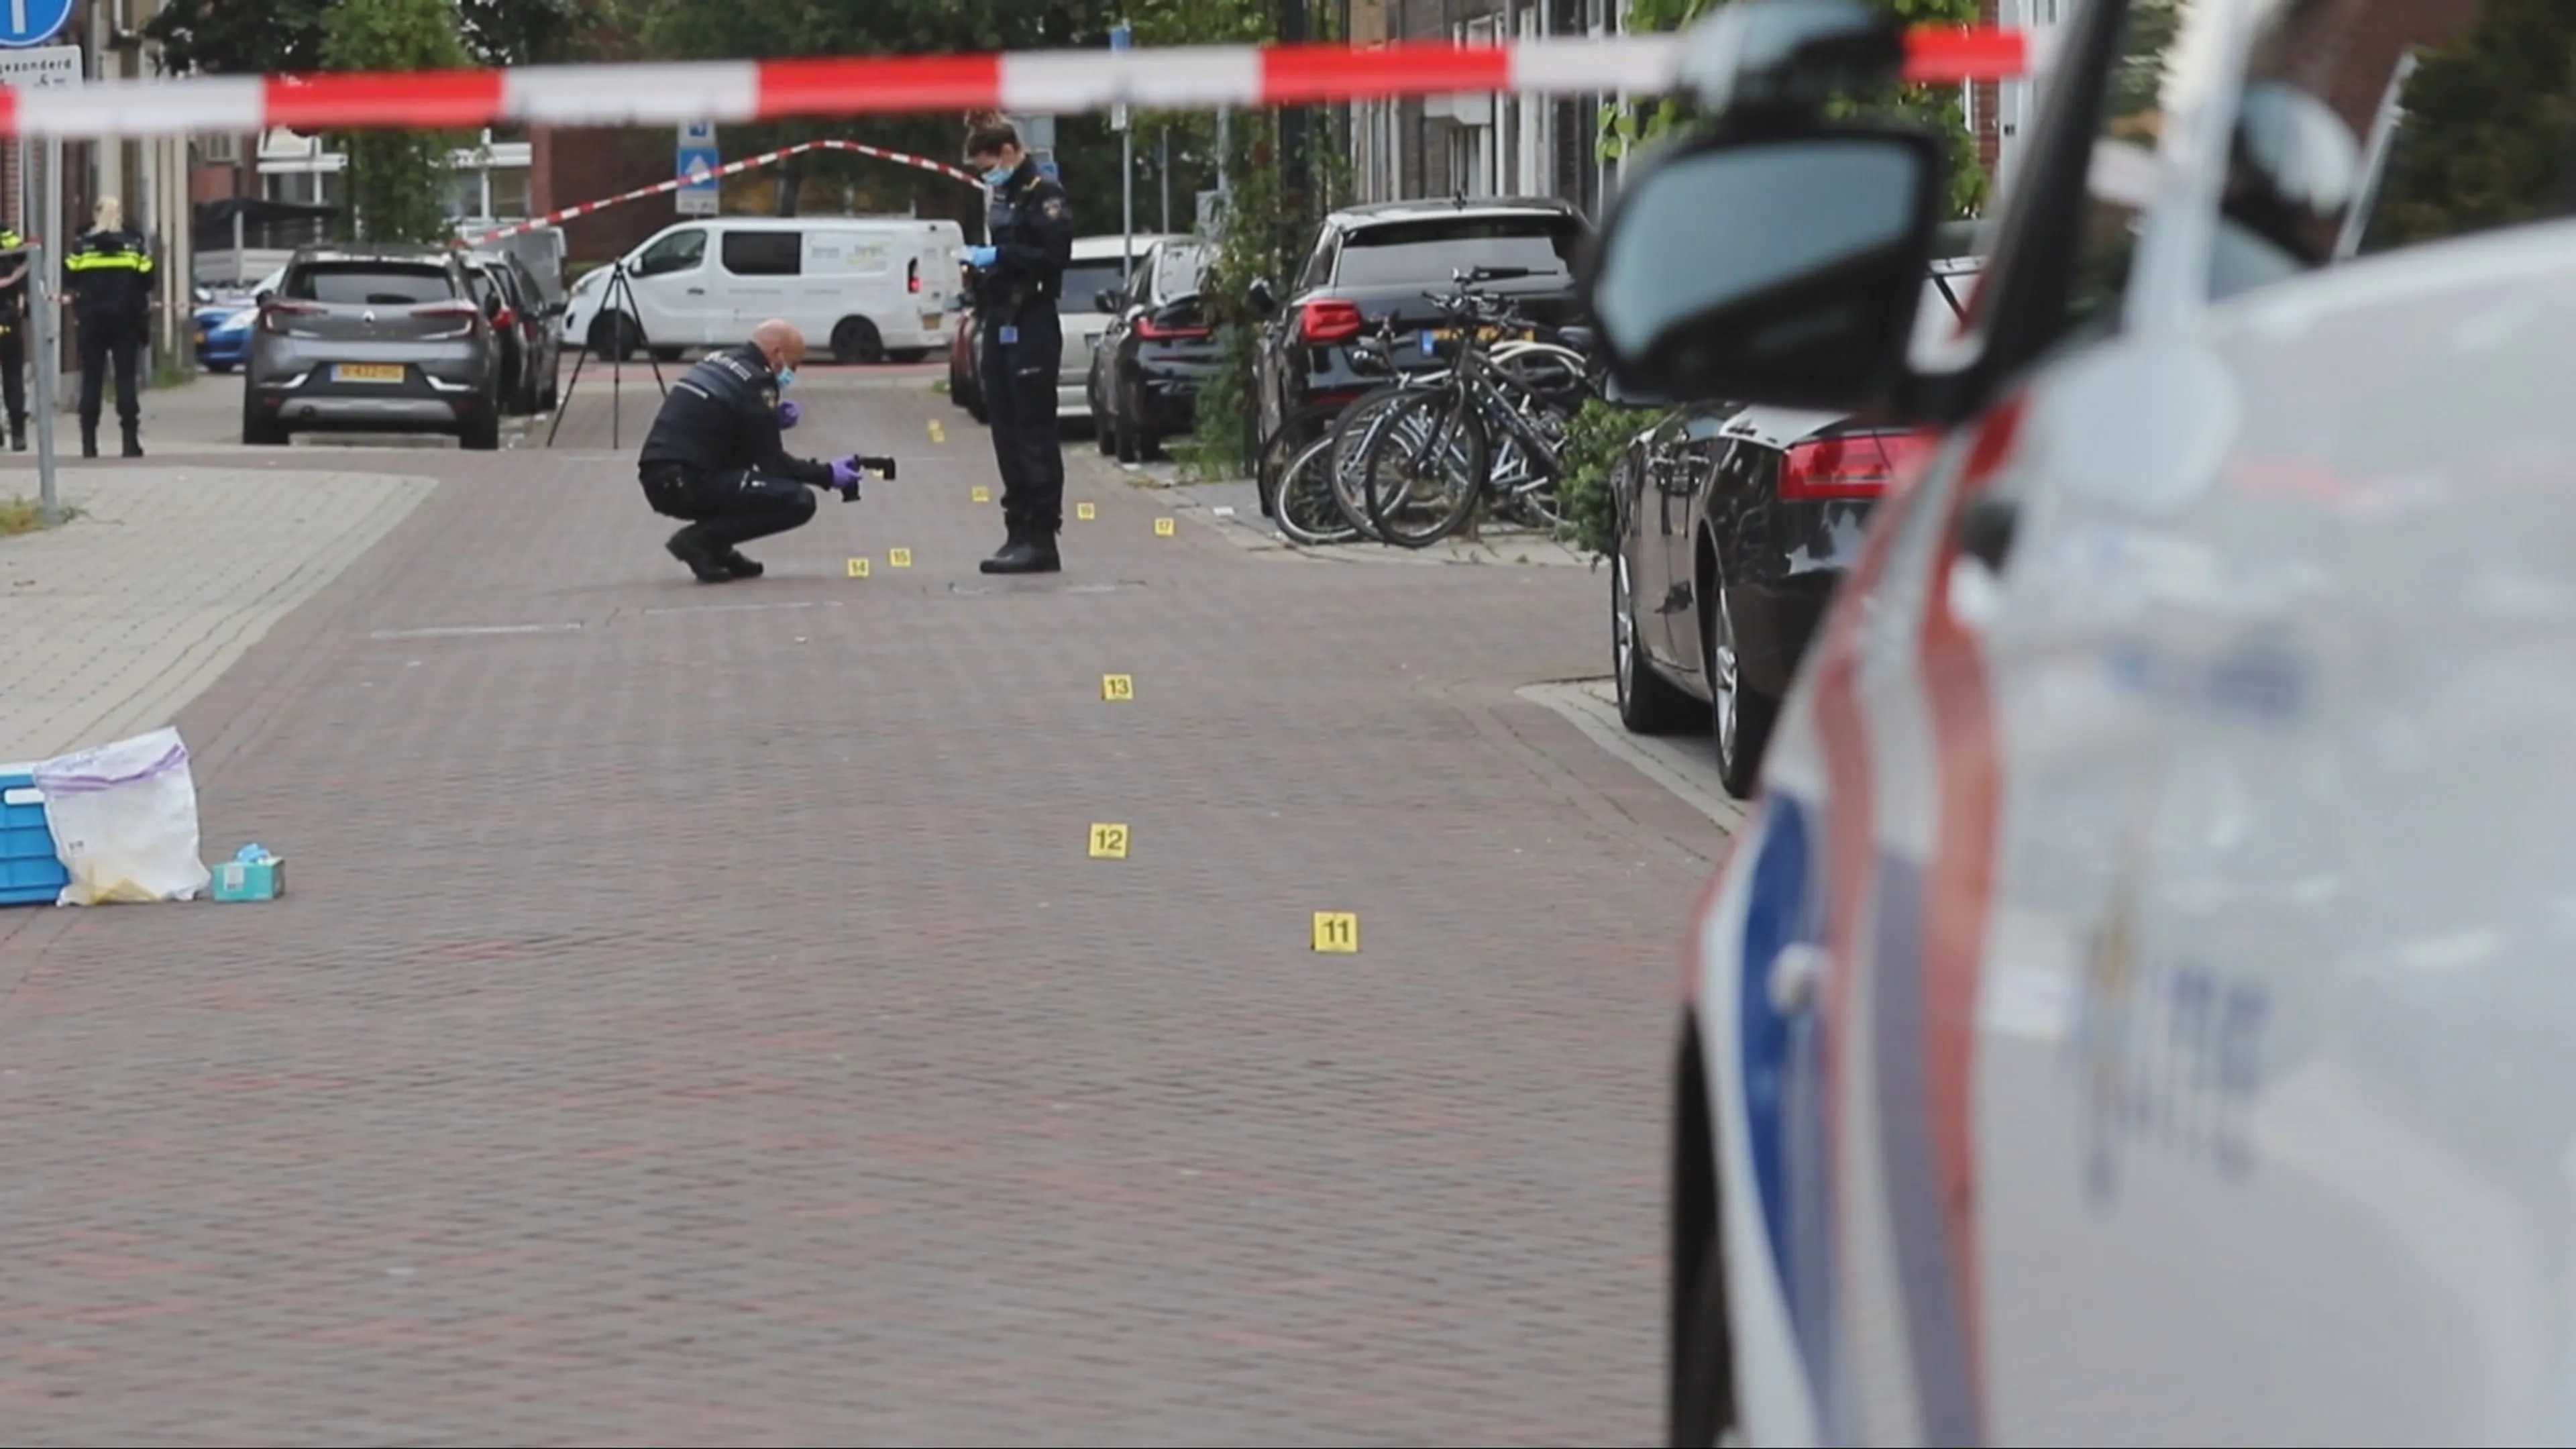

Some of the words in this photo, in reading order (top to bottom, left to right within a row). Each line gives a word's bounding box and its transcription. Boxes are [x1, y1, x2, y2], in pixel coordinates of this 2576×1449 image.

[851, 560, 866, 573] 14
[1108, 678, 1129, 695] 13
[1095, 829, 1123, 851] 12
[1322, 920, 1348, 943] 11
